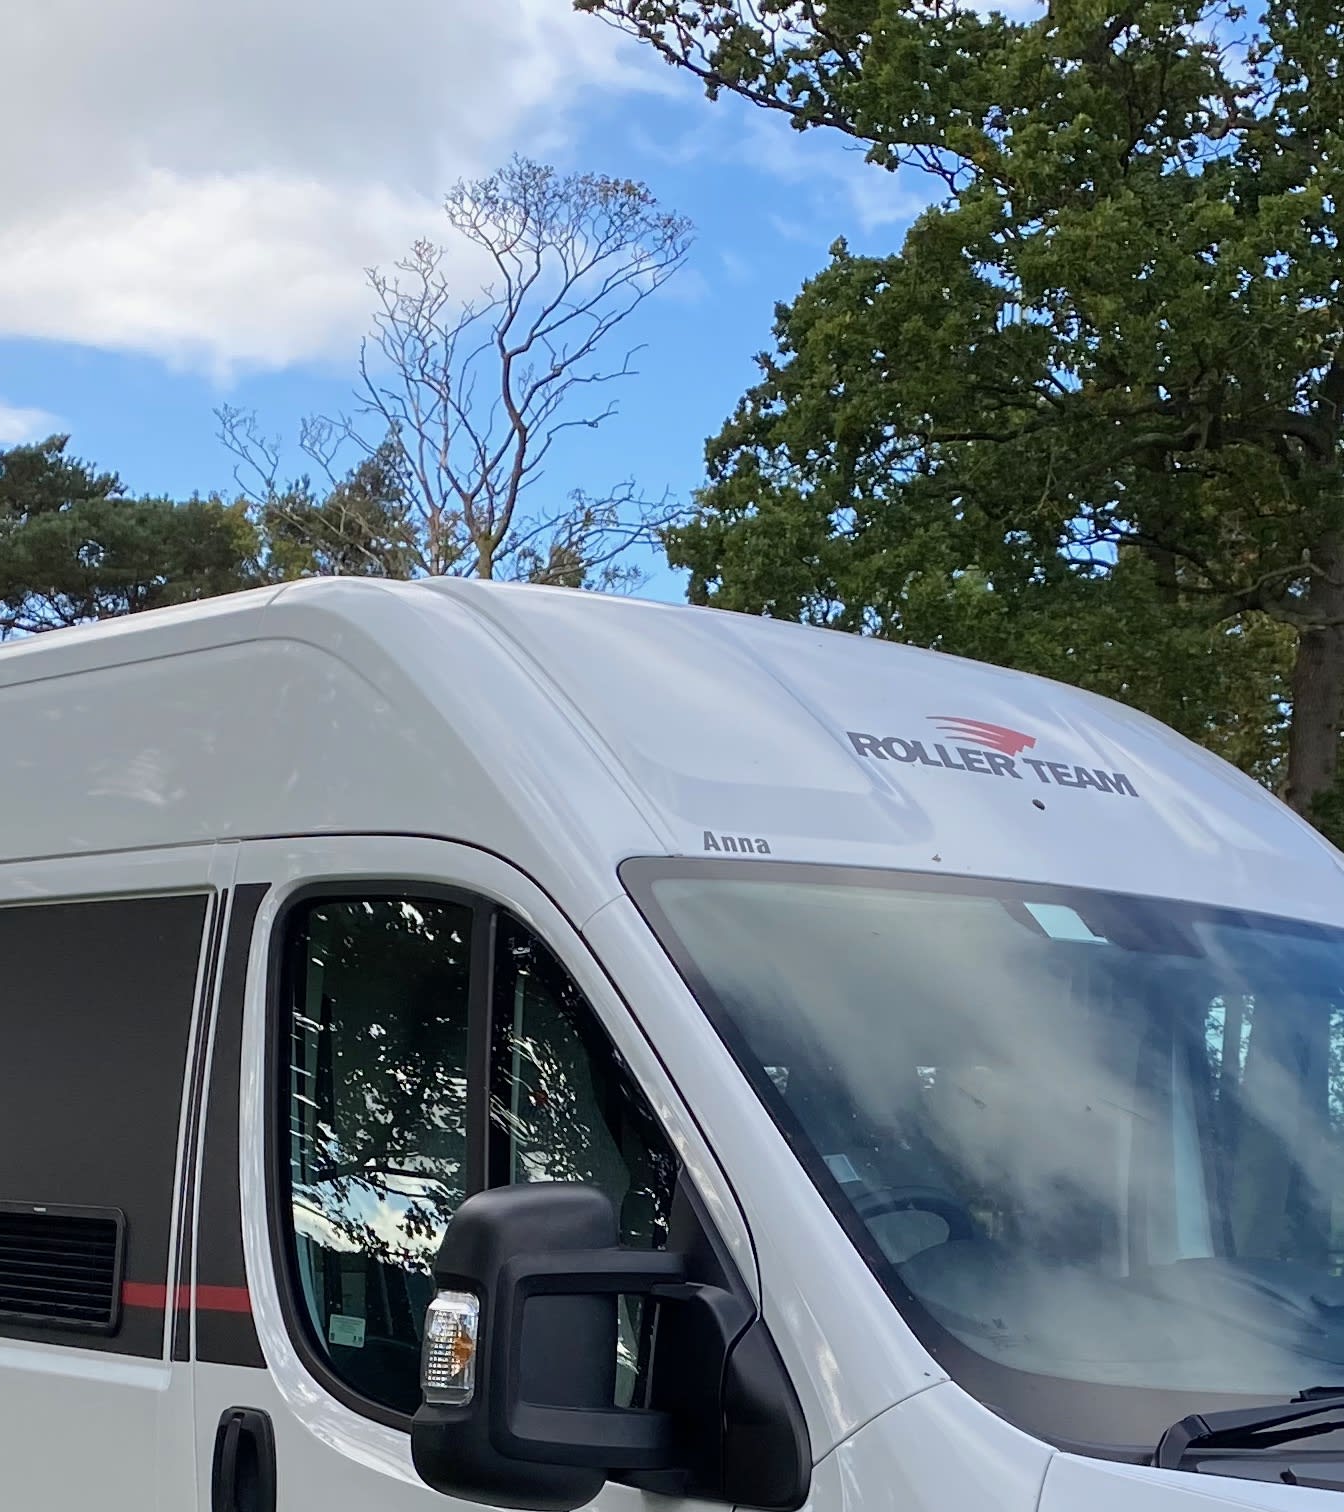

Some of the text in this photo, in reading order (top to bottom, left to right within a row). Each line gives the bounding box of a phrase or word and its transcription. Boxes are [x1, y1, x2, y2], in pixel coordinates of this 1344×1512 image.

[846, 731, 1140, 798] ROLLER TEAM
[702, 830, 771, 855] Anna
